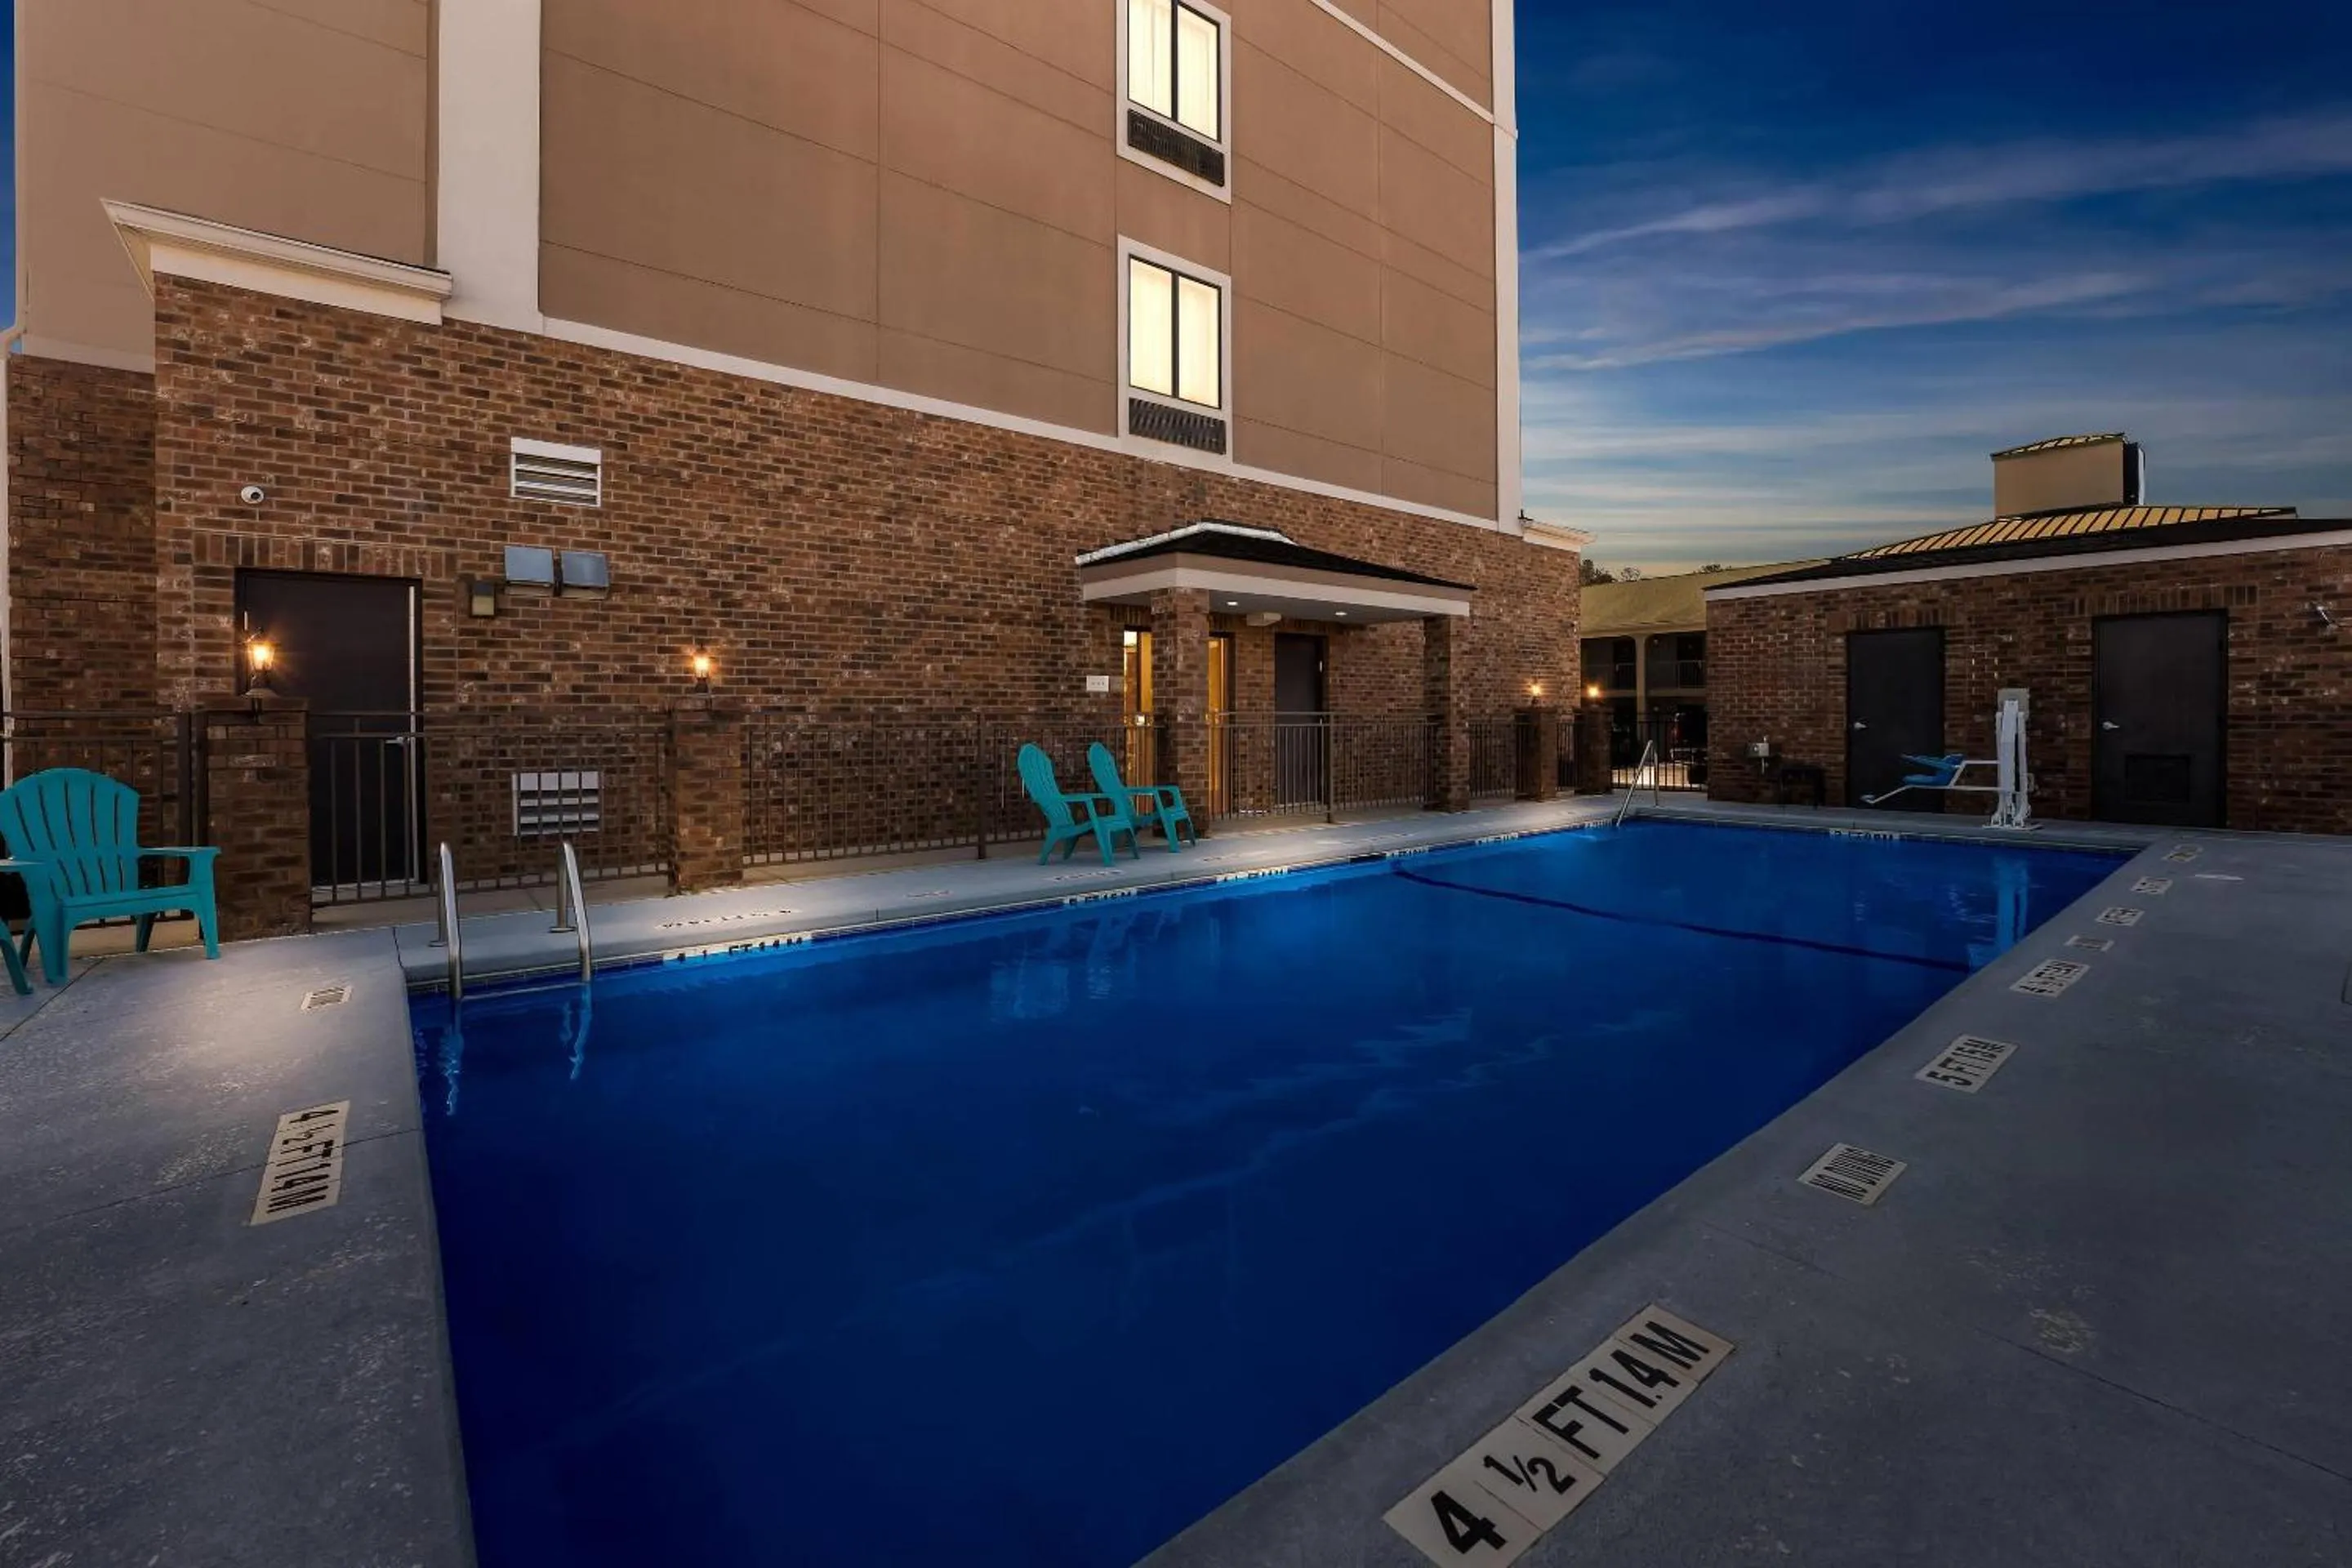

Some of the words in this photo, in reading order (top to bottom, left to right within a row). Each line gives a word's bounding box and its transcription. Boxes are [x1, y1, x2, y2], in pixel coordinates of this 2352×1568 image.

[1927, 1071, 1973, 1087] 5
[1938, 1057, 1987, 1076] FT
[289, 1110, 339, 1124] 4
[276, 1140, 334, 1167] FT
[1824, 1147, 1895, 1186] DIVING
[1808, 1174, 1869, 1201] NO
[1430, 1490, 1506, 1554] 4
[1532, 1385, 1629, 1459] FT
